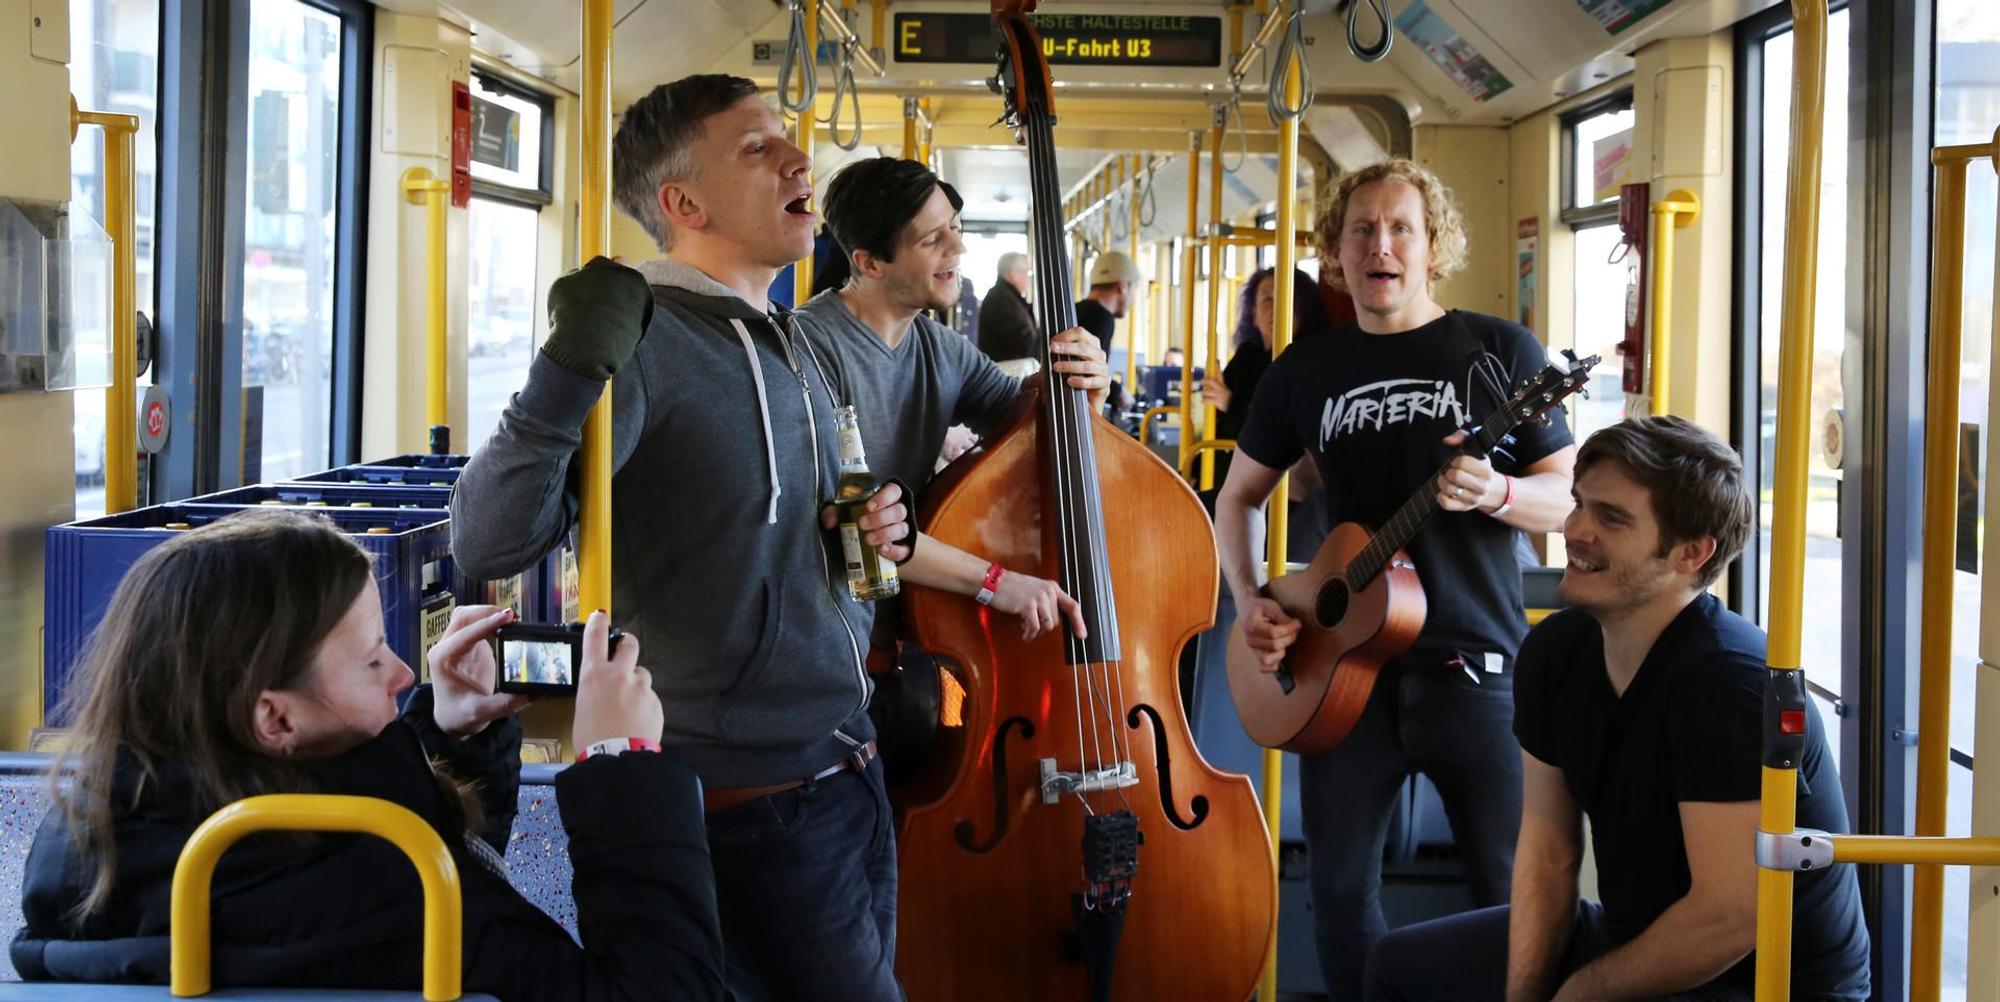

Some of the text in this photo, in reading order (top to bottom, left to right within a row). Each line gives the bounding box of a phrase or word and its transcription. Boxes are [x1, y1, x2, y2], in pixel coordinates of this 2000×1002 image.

[1082, 16, 1190, 31] HALTESTELLE
[901, 21, 922, 54] E
[1043, 38, 1151, 58] U-Fahrt U3
